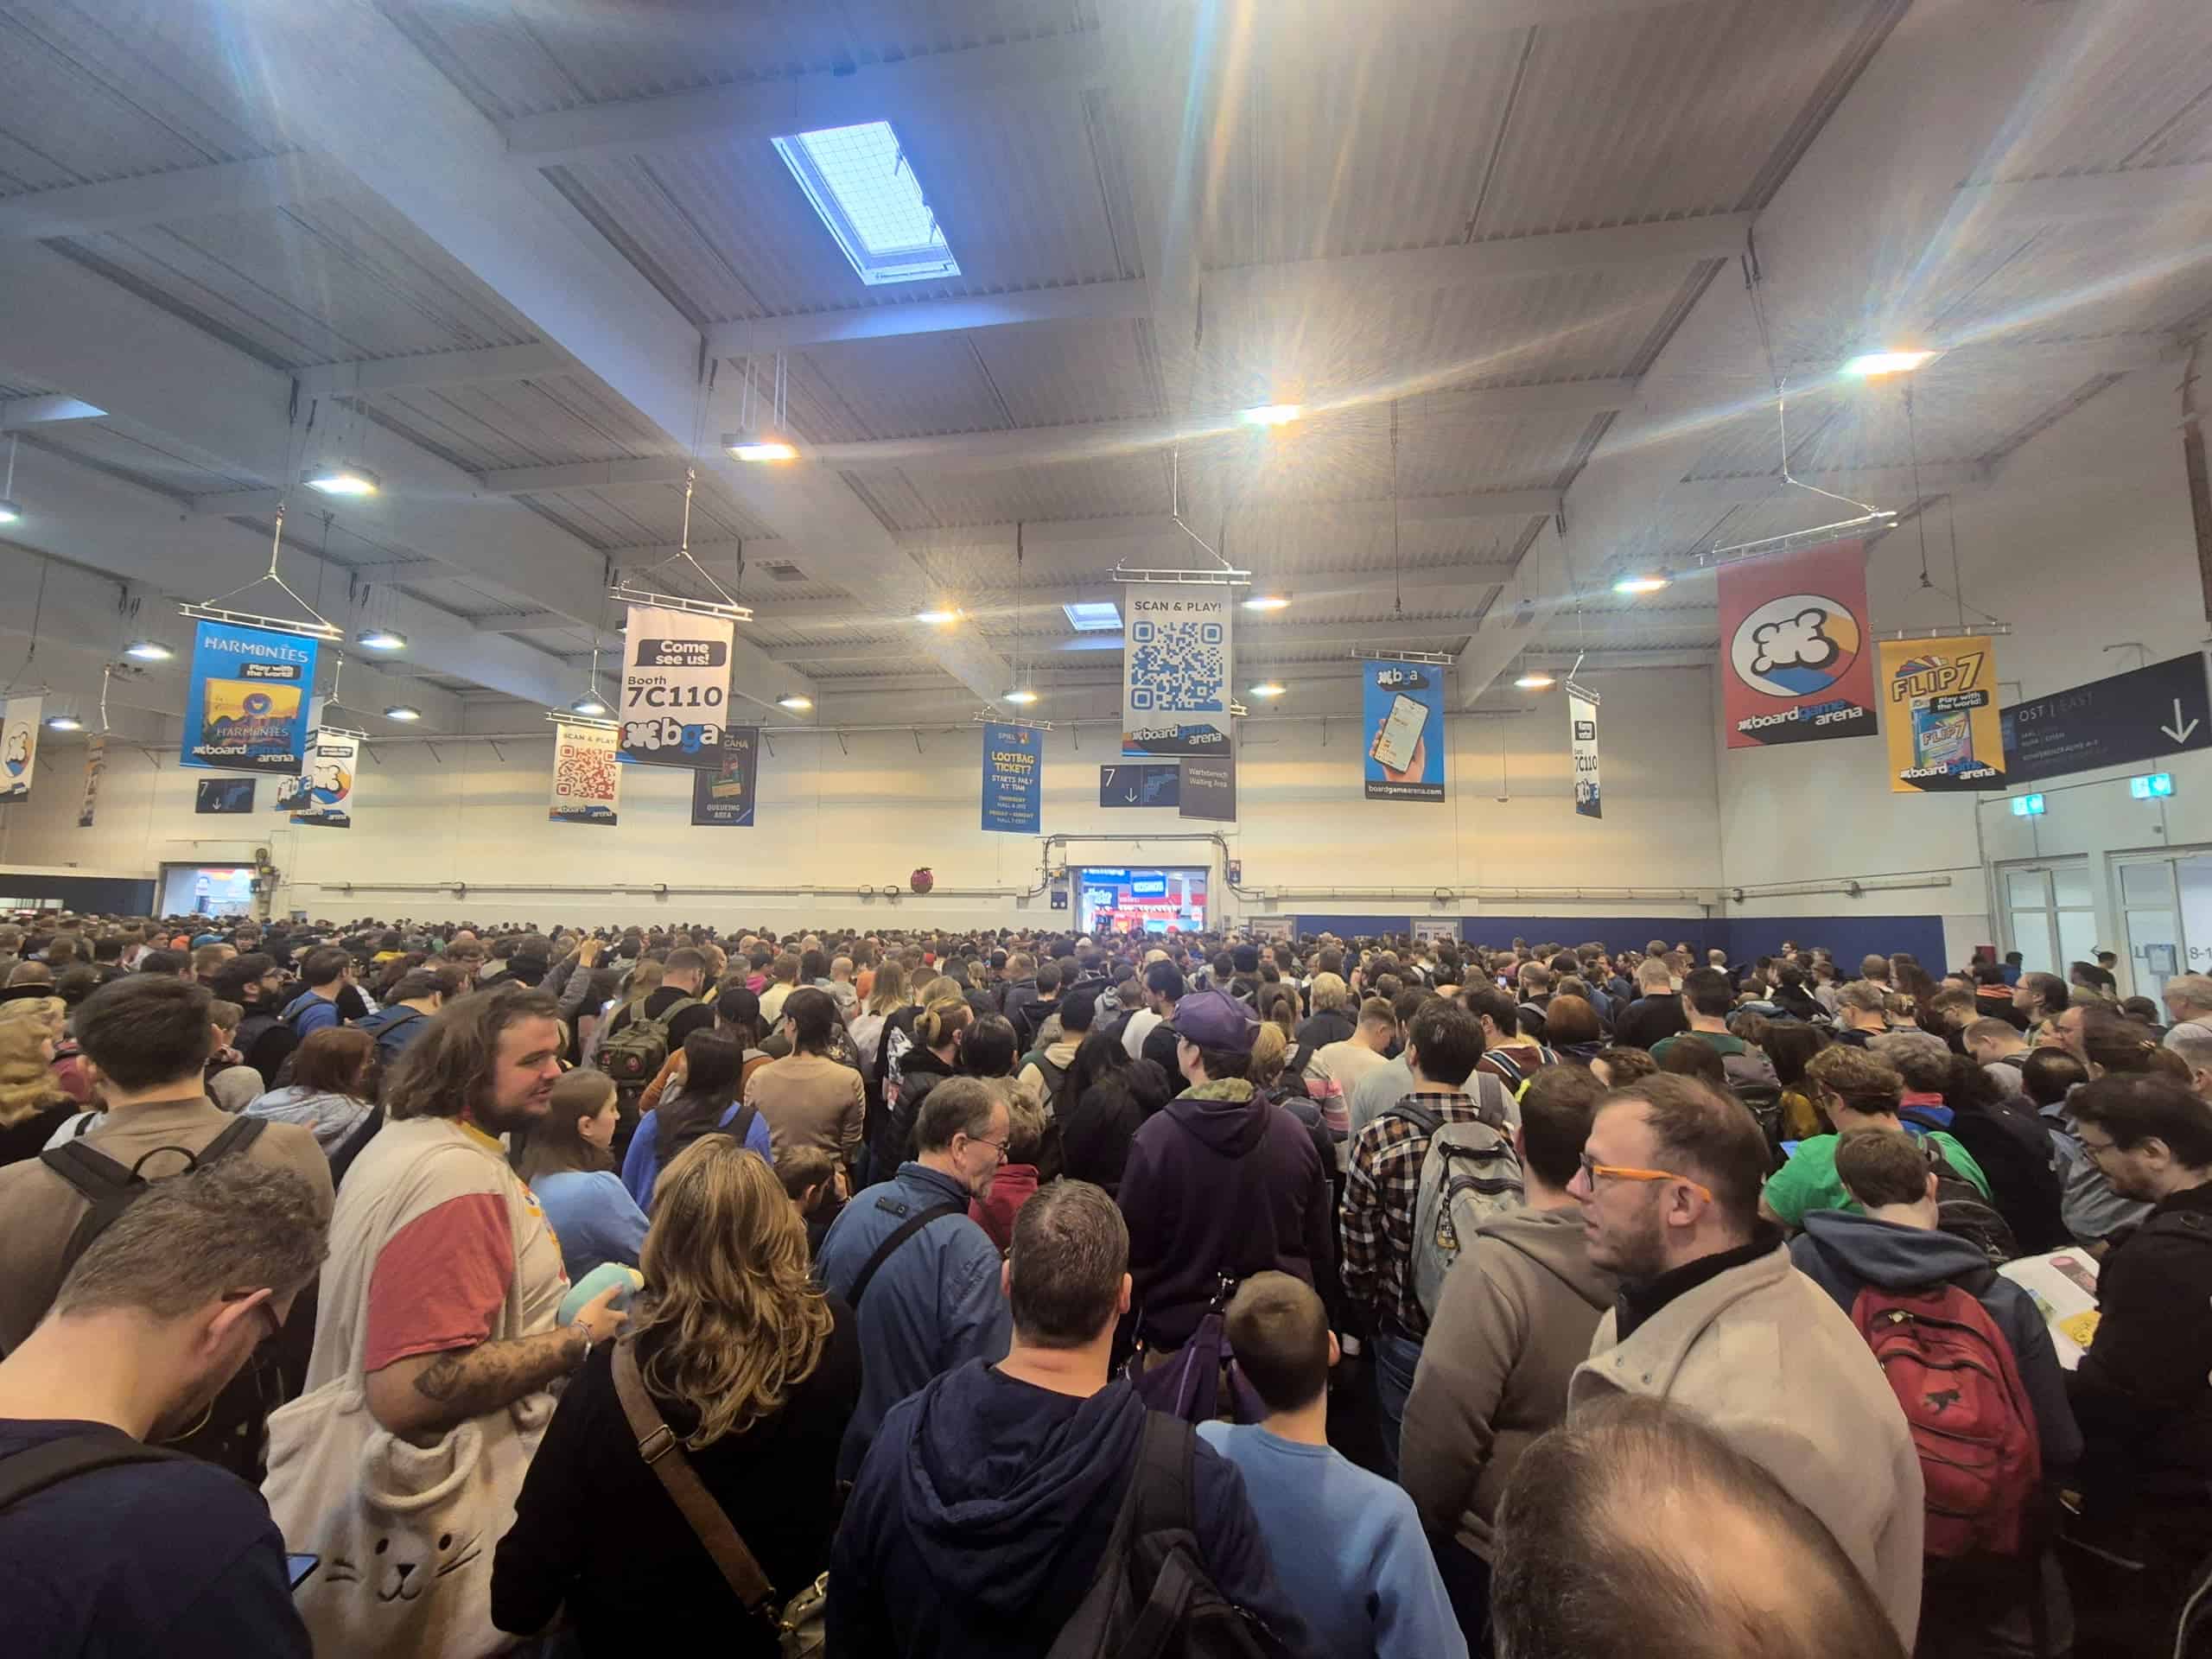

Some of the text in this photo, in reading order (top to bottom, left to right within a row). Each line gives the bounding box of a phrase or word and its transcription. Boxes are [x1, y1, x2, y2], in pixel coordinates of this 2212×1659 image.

[1135, 601, 1222, 613] SCAN & PLAY!
[204, 637, 309, 663] HARMONIES
[660, 640, 709, 653] Come
[656, 654, 709, 664] see us!
[628, 676, 666, 685] Booth
[628, 686, 722, 708] 7C110
[1938, 692, 1981, 705] Play with
[1815, 707, 1863, 726] arena
[217, 726, 289, 736] HARMONIES
[661, 718, 719, 753] bga
[1189, 732, 1223, 746] arena
[257, 753, 295, 763] arena
[992, 751, 1034, 765] LOOTBAG
[995, 761, 1032, 775] TICKET?
[1960, 767, 1995, 780] arena
[1103, 768, 1116, 787] 7
[1189, 779, 1228, 788] Waiting Area
[200, 781, 209, 798] 7
[1369, 785, 1442, 796] boardgamearena.com
